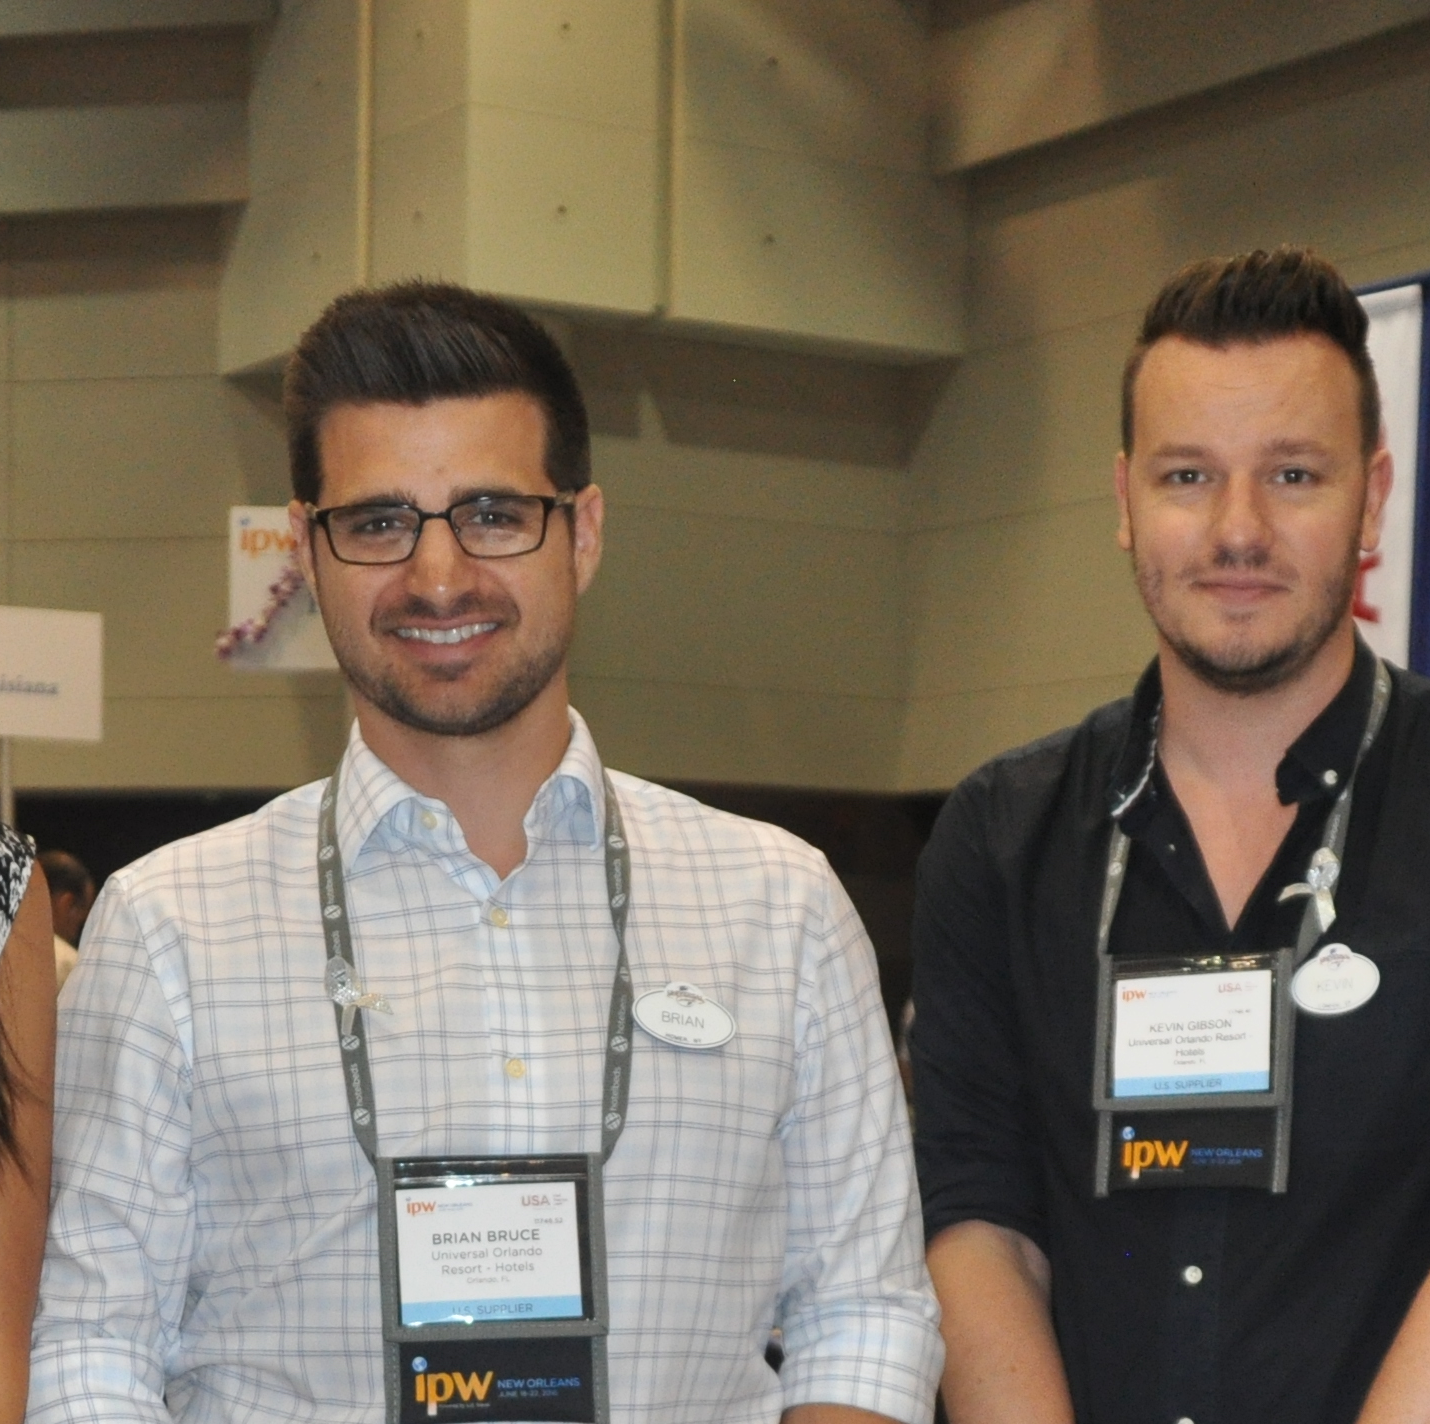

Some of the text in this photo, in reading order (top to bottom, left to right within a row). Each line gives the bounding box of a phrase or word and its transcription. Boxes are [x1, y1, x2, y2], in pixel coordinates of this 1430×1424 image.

[1121, 986, 1146, 1002] ipw
[1218, 983, 1241, 993] USA
[661, 1011, 705, 1029] BRIAN
[1149, 1019, 1232, 1033] KEVIN GIBSON
[1128, 1036, 1172, 1048] Universal
[1175, 1034, 1213, 1045] Orlando
[1216, 1032, 1247, 1042] Resort
[1174, 1079, 1222, 1090] SUPPLIER
[1121, 1126, 1188, 1179] ipw
[1216, 1148, 1263, 1159] ORLEANS
[405, 1196, 437, 1217] ipw
[521, 1195, 551, 1208] USA
[432, 1228, 541, 1245] BRIAN BRUCE
[431, 1246, 543, 1262] Universal Orlando
[441, 1264, 482, 1275] Resort
[495, 1261, 535, 1273] Hotels
[477, 1303, 533, 1315] SUPPLIER
[412, 1356, 494, 1416] ipw
[498, 1376, 580, 1389] NEW ORLEANS
